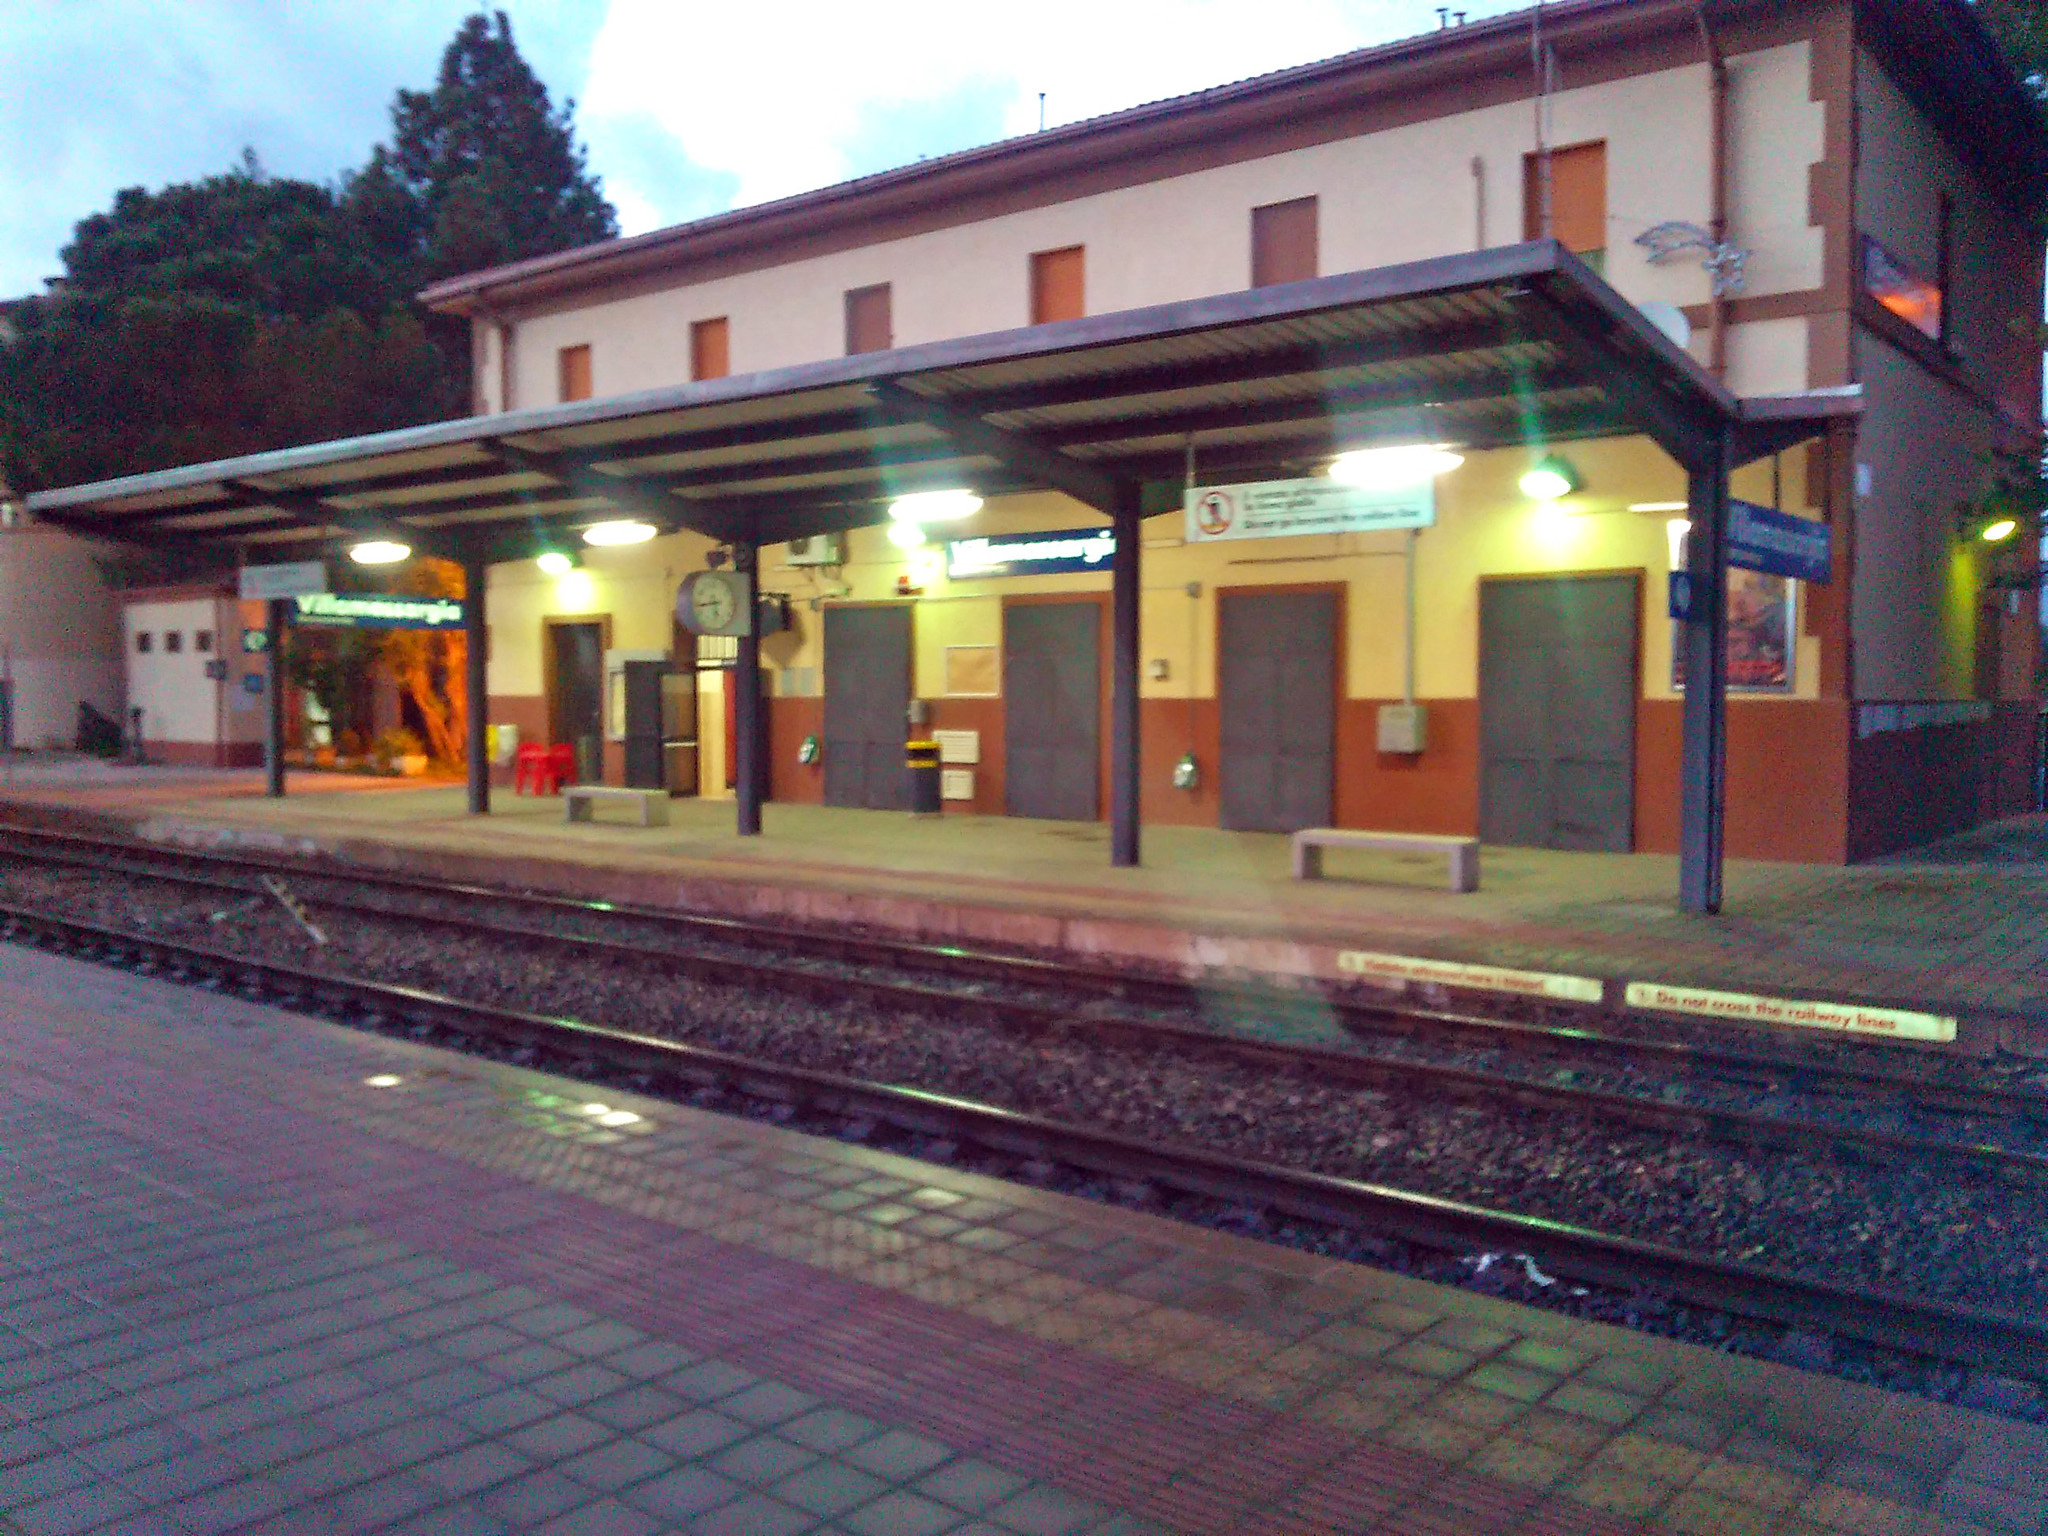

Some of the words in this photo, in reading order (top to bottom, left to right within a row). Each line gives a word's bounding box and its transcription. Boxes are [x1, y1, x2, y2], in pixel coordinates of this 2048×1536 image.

[1656, 989, 1678, 1005] Do
[1682, 997, 1707, 1009] not
[1712, 1000, 1750, 1013] cross
[1755, 1003, 1781, 1016] the
[1787, 1009, 1850, 1028] railway
[1856, 1013, 1896, 1030] lines
